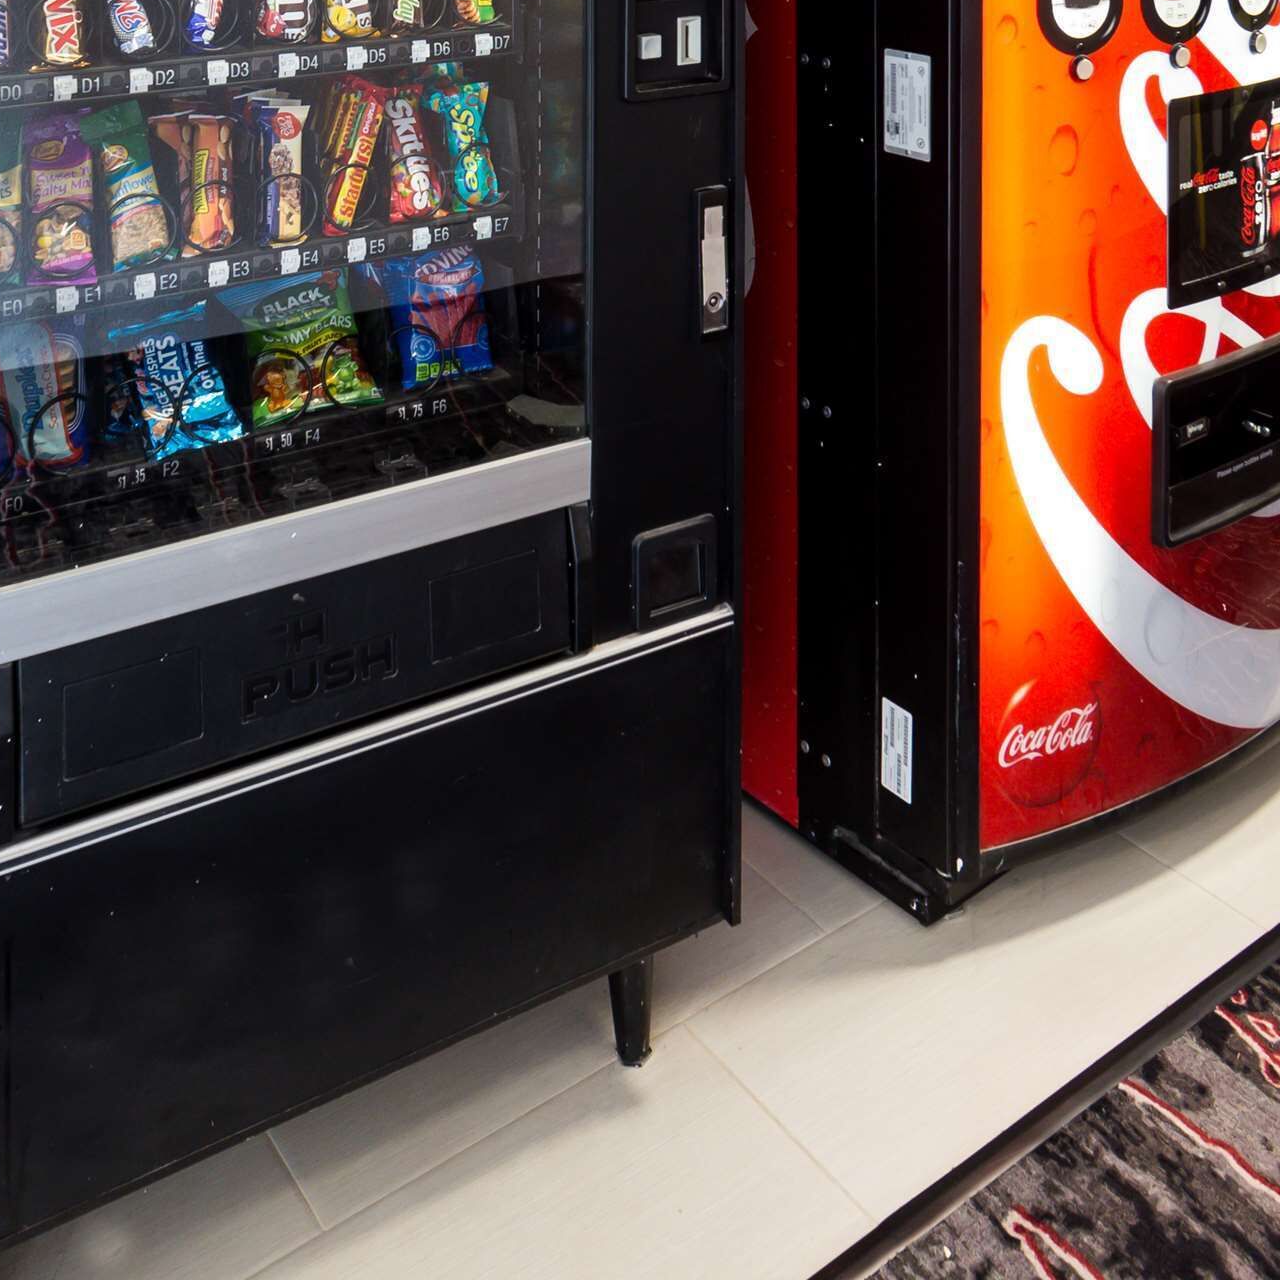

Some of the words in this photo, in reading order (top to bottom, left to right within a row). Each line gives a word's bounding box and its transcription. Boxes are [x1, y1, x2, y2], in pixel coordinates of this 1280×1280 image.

[433, 41, 451, 57] D6
[495, 35, 510, 49] D7
[301, 55, 319, 70] D4
[369, 48, 386, 64] D5
[155, 69, 176, 85] D2
[231, 62, 249, 78] D3
[0, 85, 21, 101] D0
[82, 77, 100, 94] D1
[361, 102, 376, 135] Original
[385, 99, 430, 211] Skittles
[36, 171, 76, 185] Sweet
[1180, 179, 1193, 190] real
[33, 183, 69, 201] Salty
[1240, 166, 1256, 246] Coca-Cola
[1254, 180, 1266, 226] zero
[495, 217, 509, 232] E7
[434, 227, 450, 242] E6
[369, 238, 386, 254] E5
[303, 249, 319, 266] E4
[232, 262, 250, 278] E3
[159, 273, 177, 290] E2
[84, 287, 101, 302] E1
[262, 286, 325, 315] BLACK
[3, 300, 23, 317] E0
[191, 341, 216, 390] original
[432, 399, 448, 416] F6
[305, 428, 321, 447] F4
[163, 460, 180, 478] F2
[5, 496, 23, 513] F0
[241, 632, 400, 726] PUSH
[998, 702, 1098, 768] Coca-Cola
